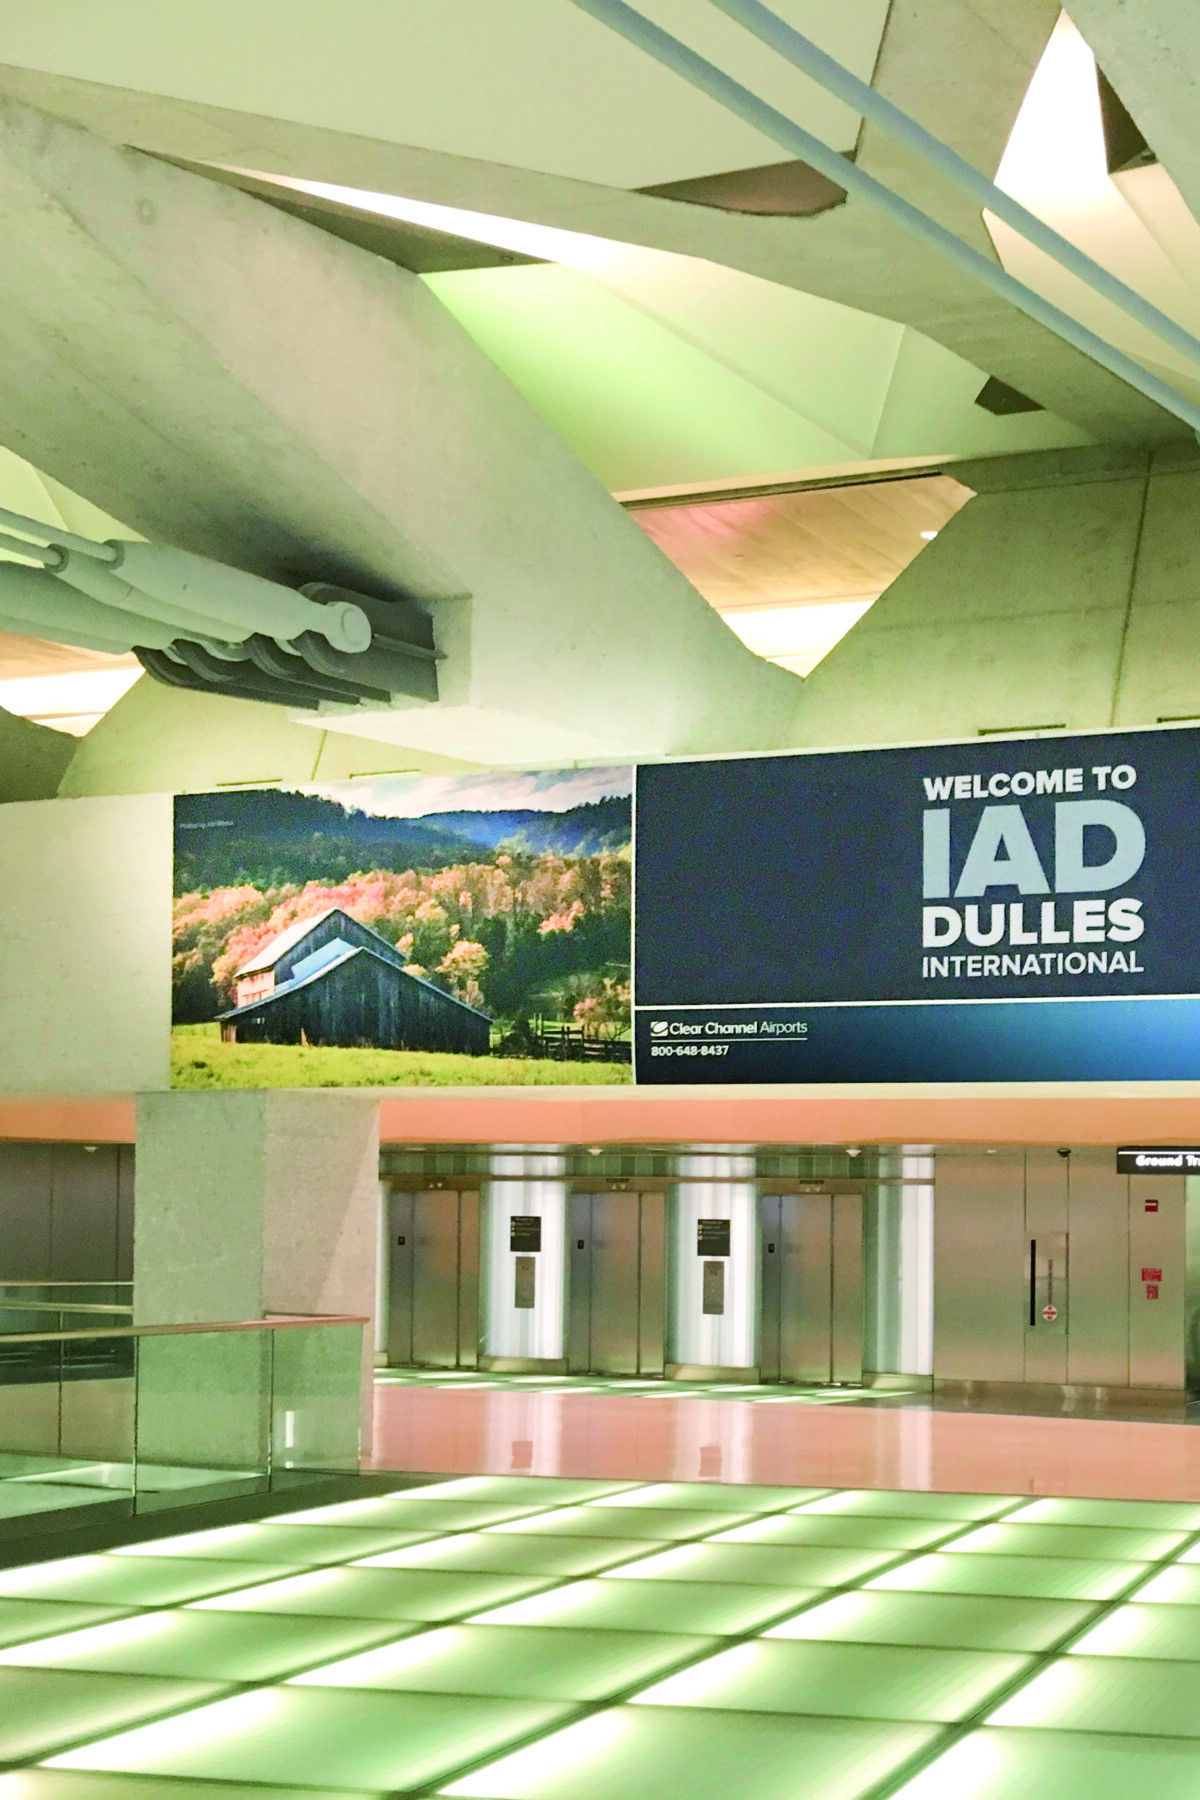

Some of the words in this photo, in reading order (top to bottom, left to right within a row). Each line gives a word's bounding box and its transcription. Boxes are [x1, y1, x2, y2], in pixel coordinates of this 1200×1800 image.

[923, 767, 1084, 801] WELCOME
[1091, 764, 1138, 791] TO
[923, 799, 1147, 899] IAD
[922, 897, 1145, 948] DULLES
[922, 950, 1145, 978] INTERNATIONAL
[669, 1022, 704, 1035] Clear
[705, 1021, 758, 1035] Channel
[760, 1021, 808, 1036] Airports
[651, 1045, 729, 1057] 800-648-8437
[1135, 1154, 1183, 1167] Ground
